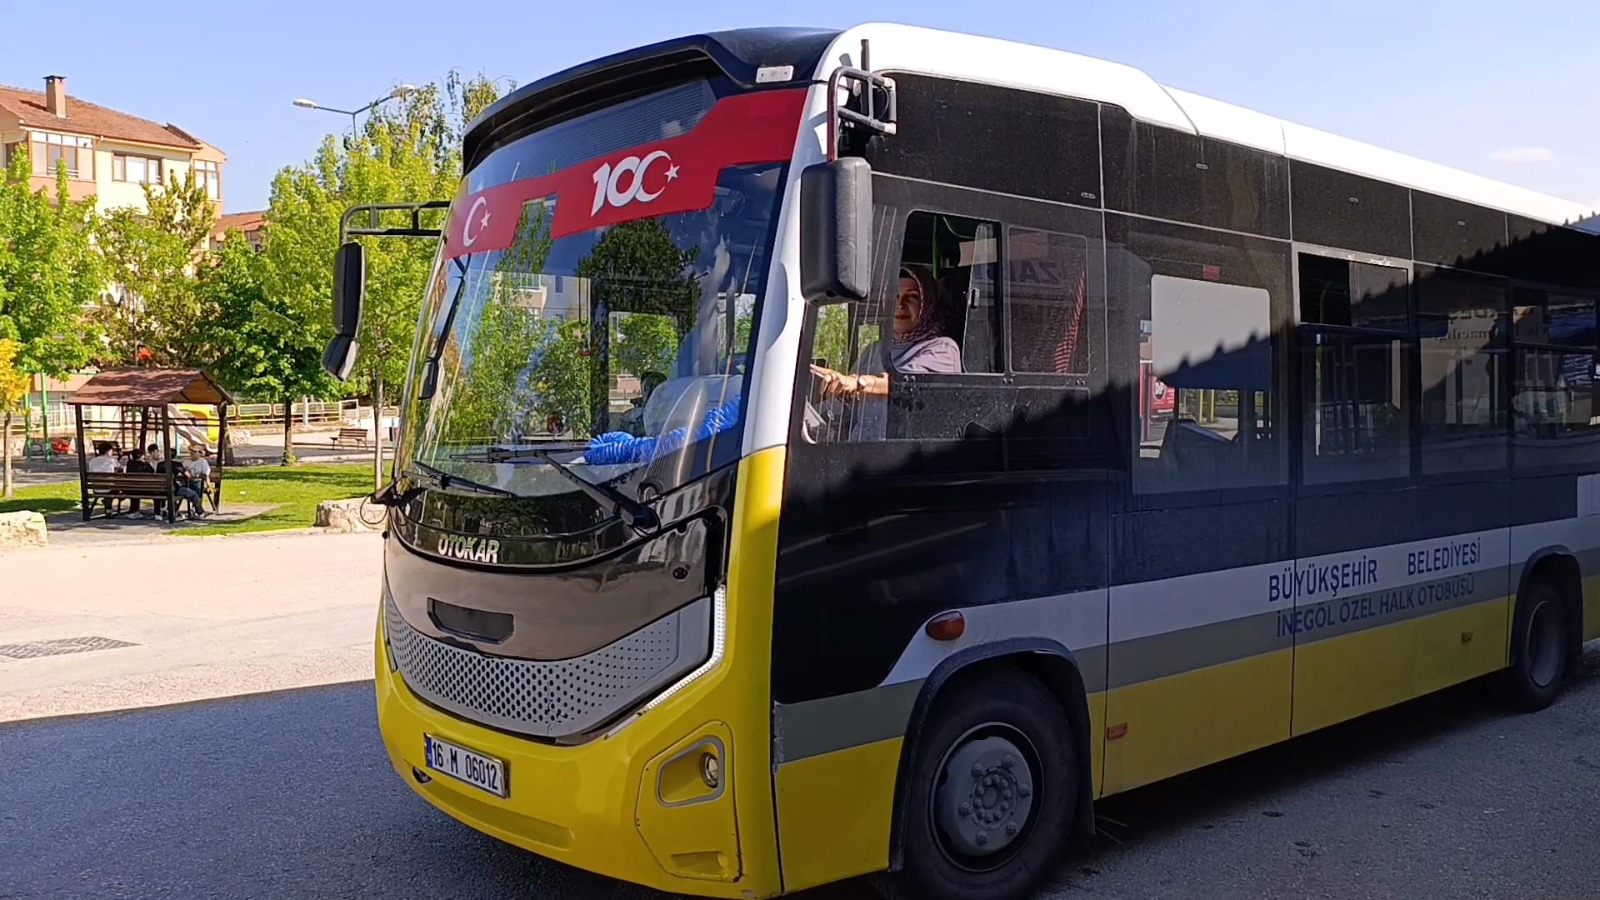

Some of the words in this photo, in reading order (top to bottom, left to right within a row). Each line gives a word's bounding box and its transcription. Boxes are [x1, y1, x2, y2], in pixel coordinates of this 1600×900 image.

[591, 150, 672, 217] 100
[438, 533, 500, 564] OTOKAR
[1268, 555, 1378, 602] BÜYÜKŞEHİR
[1407, 537, 1481, 576] BELEDİYESİ
[1276, 602, 1335, 638] İNEGÖL
[1339, 597, 1376, 624] ÖZEL
[1380, 588, 1414, 615] HALK
[1418, 573, 1475, 606] OTOBÜSÜ
[433, 741, 444, 768] 16
[450, 748, 459, 774] M
[465, 754, 499, 791] 06012
